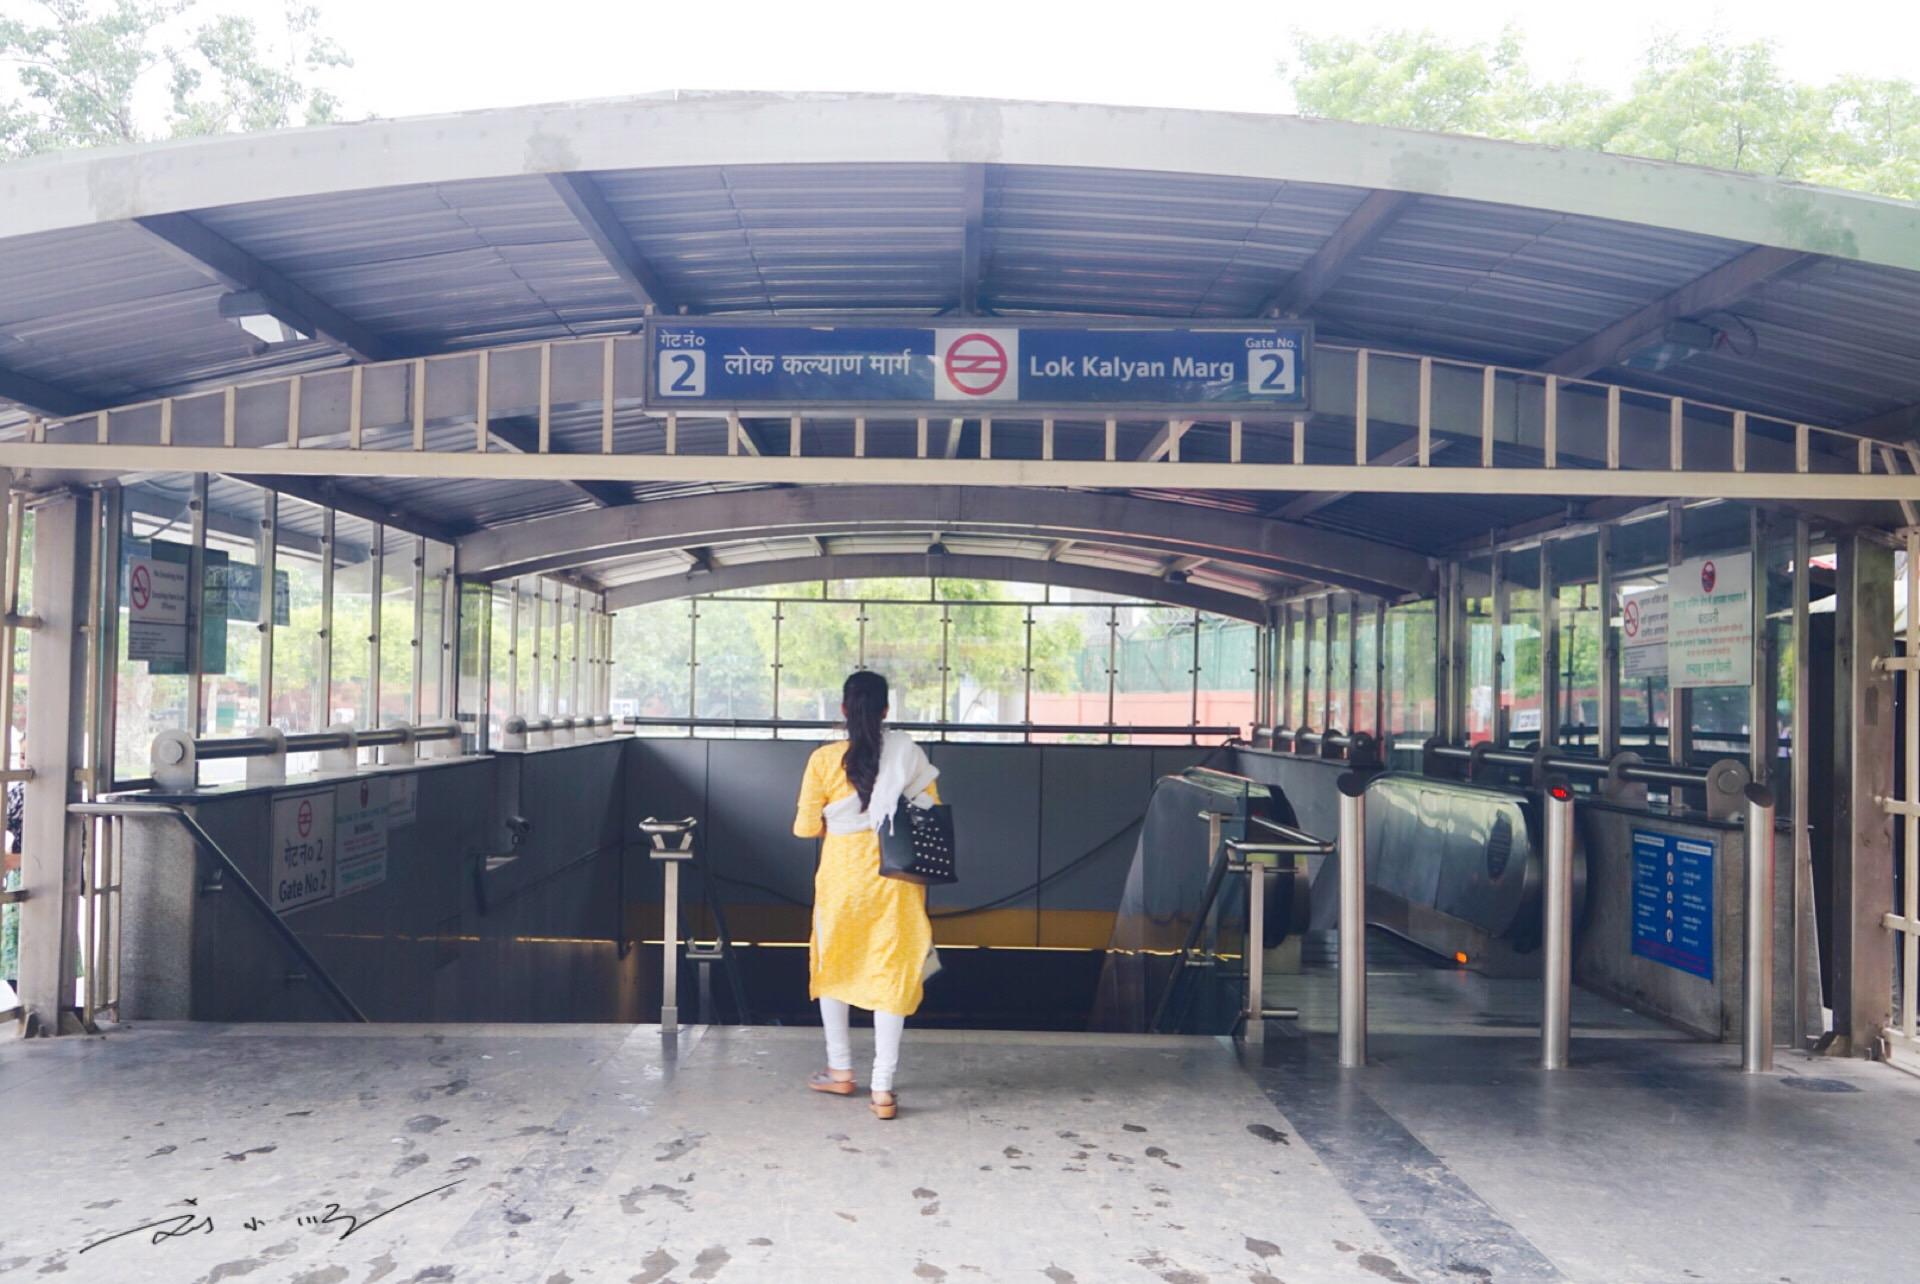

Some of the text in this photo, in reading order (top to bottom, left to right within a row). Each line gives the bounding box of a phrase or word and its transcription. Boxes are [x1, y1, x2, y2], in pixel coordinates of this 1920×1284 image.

[660, 329, 681, 348] गेट
[1245, 337, 1297, 349] Gate No.
[670, 354, 697, 392] 2
[723, 347, 912, 375] लोक कल्याण मार्ग
[1030, 355, 1235, 383] Lok Kalyan Marg
[1259, 353, 1286, 390] 2
[284, 838, 298, 868] गेट
[316, 838, 324, 862] 2
[279, 878, 303, 903] Gate
[304, 873, 319, 895] No
[320, 868, 328, 891] 2
